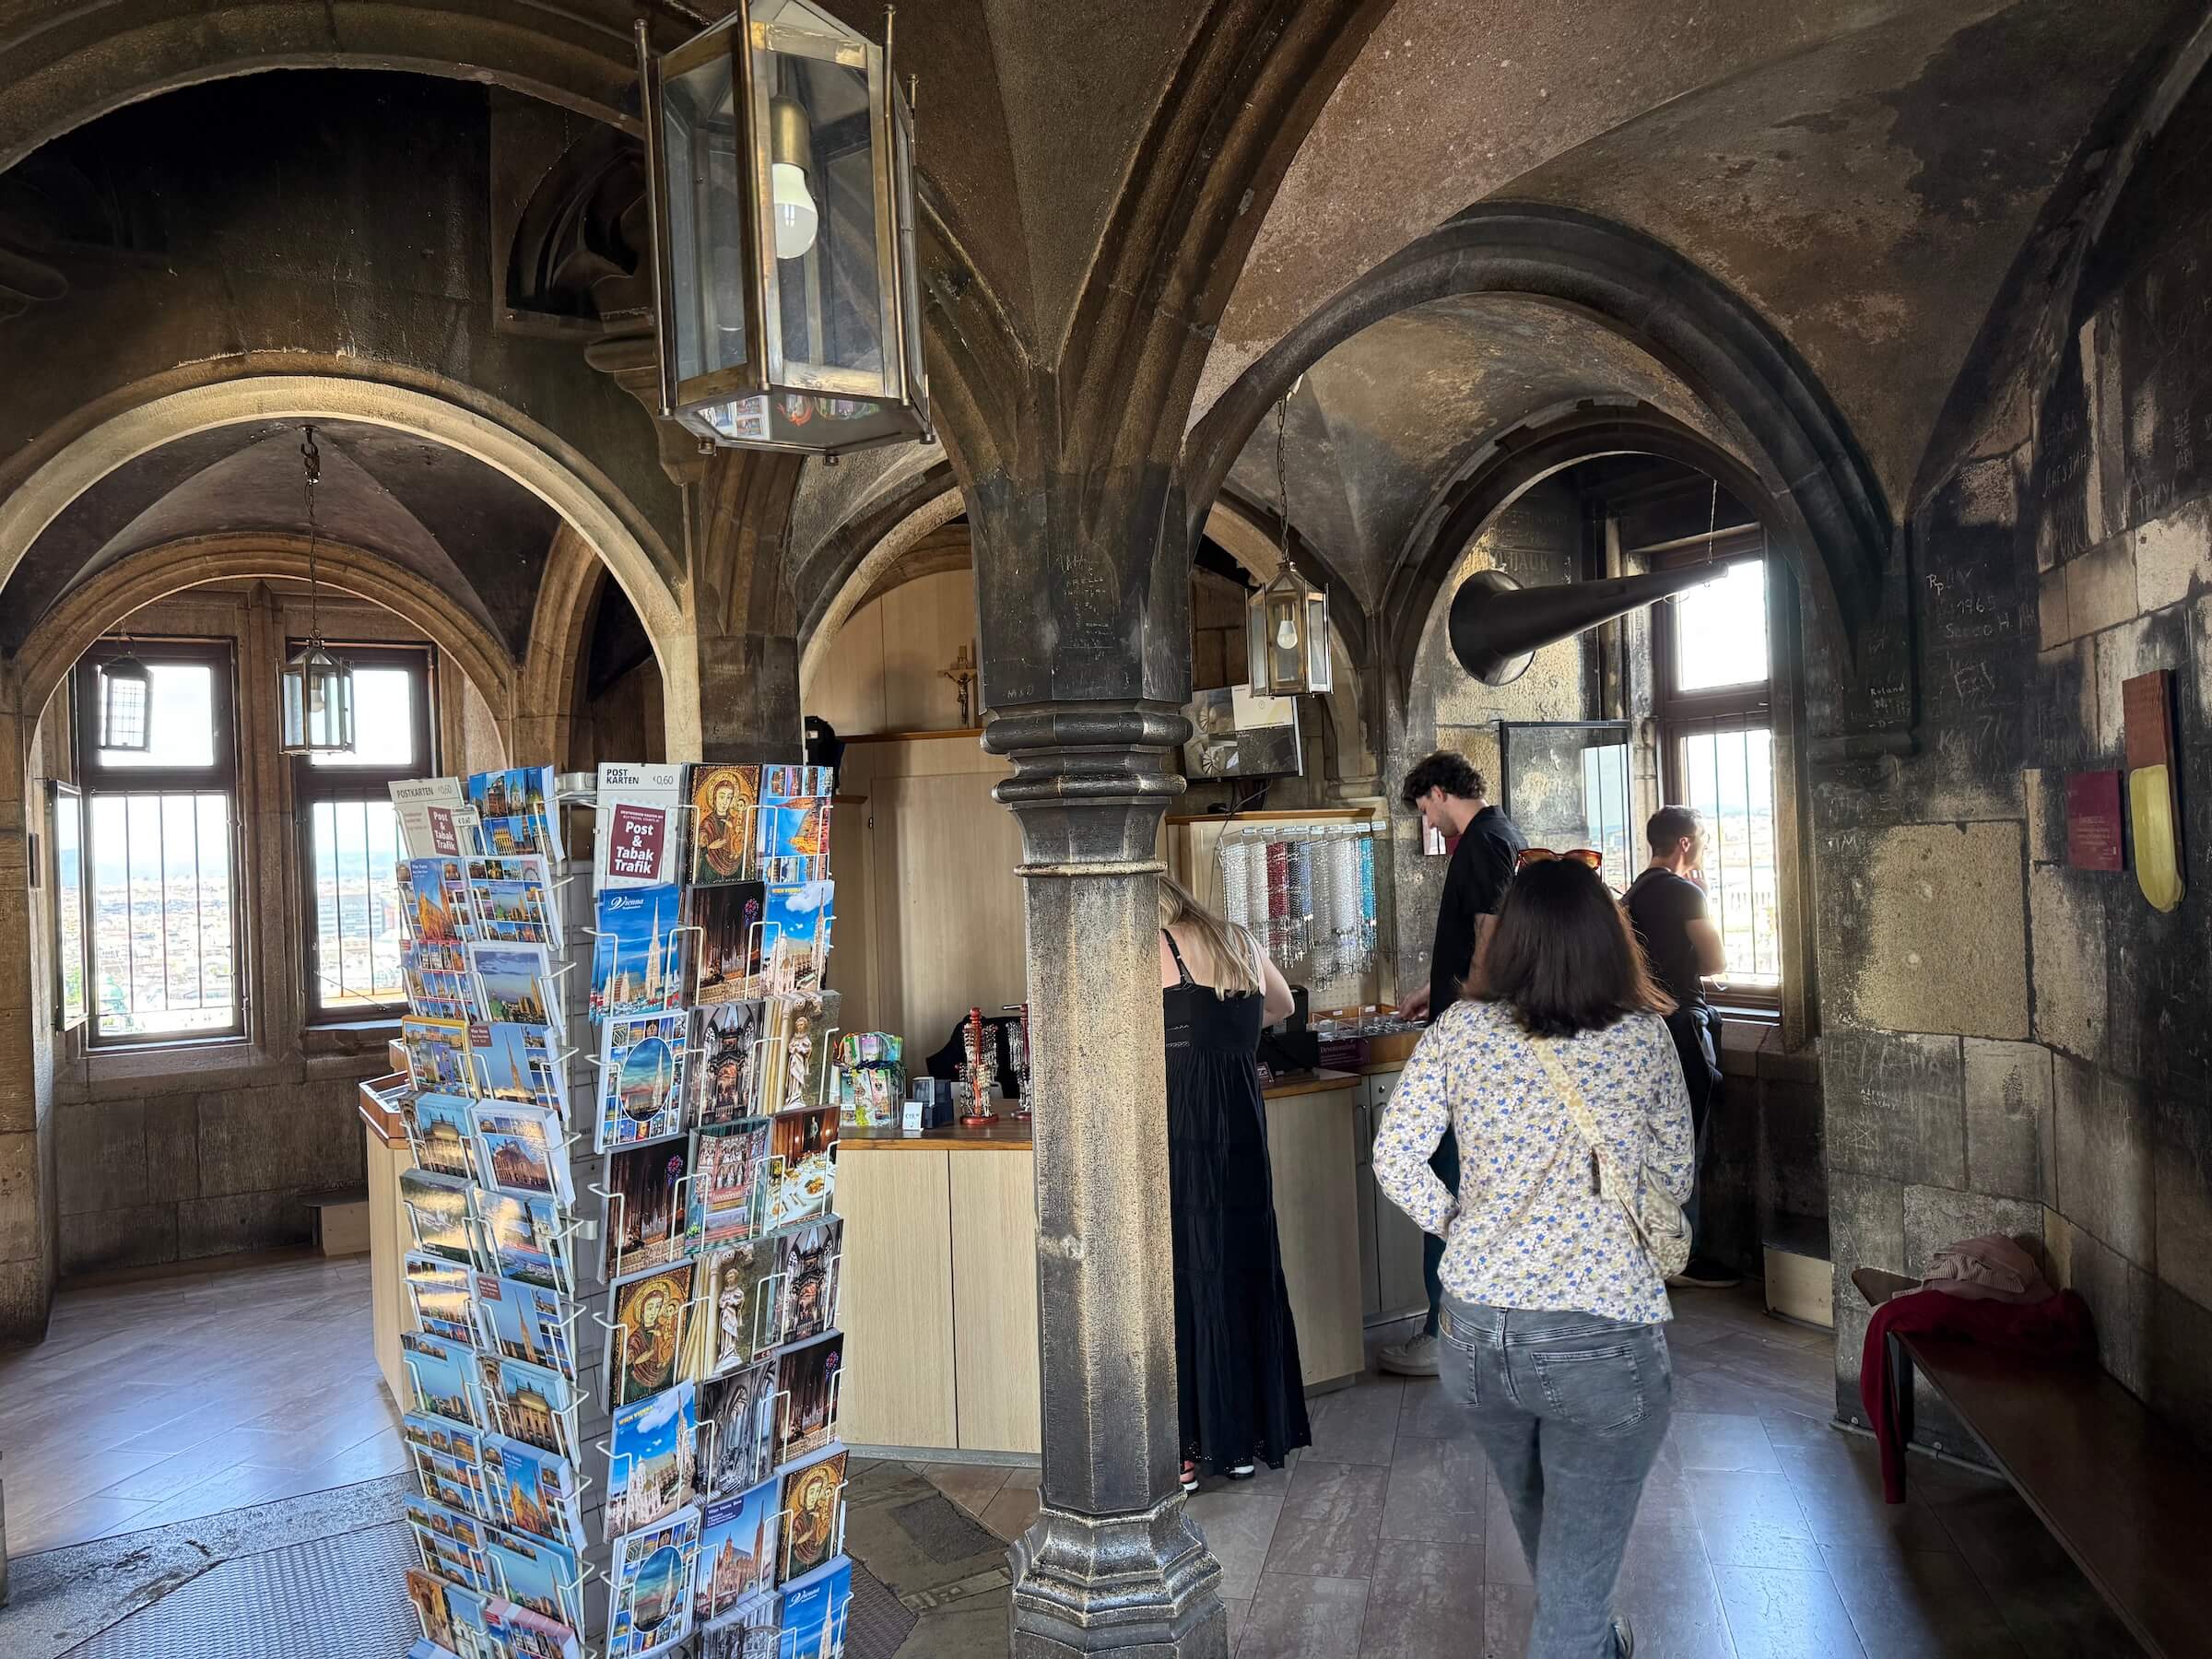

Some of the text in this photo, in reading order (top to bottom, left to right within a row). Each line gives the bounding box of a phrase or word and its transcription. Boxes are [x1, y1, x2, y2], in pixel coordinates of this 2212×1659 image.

[606, 769, 629, 777] POST
[606, 777, 640, 785] KARTEN
[396, 786, 434, 798] POSTKARTEN
[433, 811, 449, 821] Post
[625, 820, 654, 835] Post
[435, 830, 454, 841] Tabak
[632, 835, 643, 847] &
[437, 840, 456, 851] Trafik
[616, 846, 654, 862] Tabak
[615, 859, 652, 874] Trafik
[608, 896, 644, 911] Vienna
